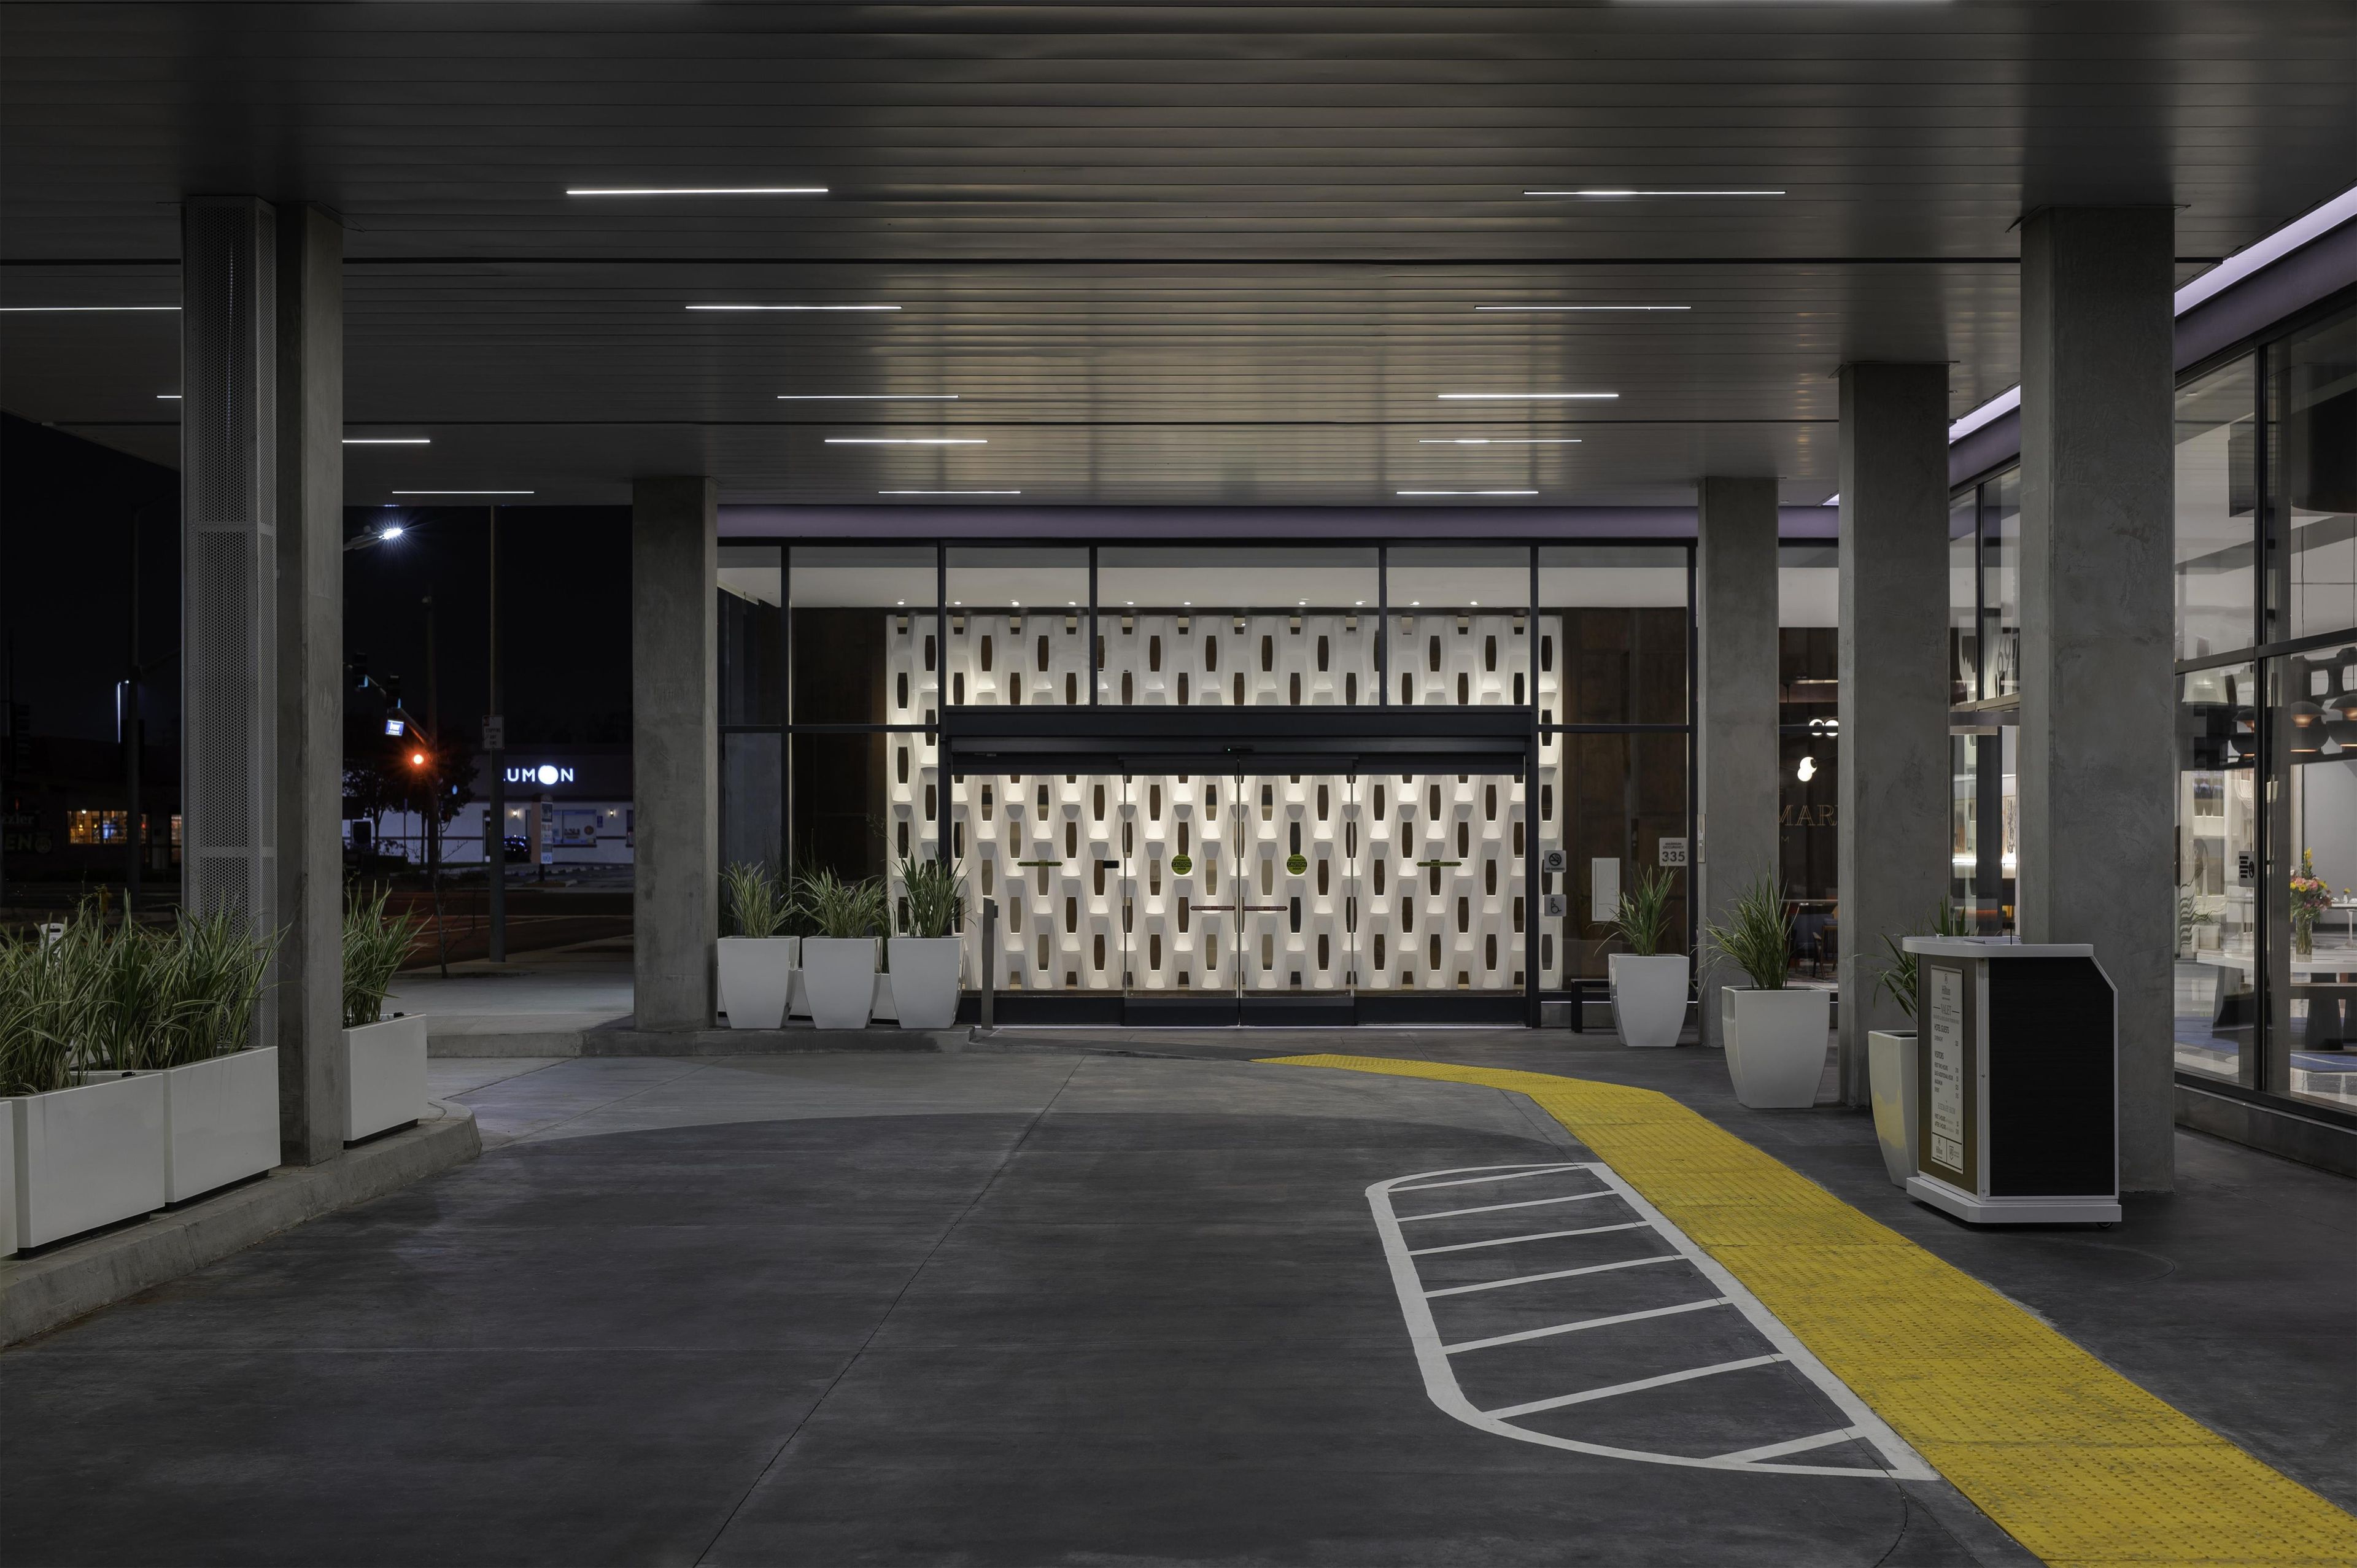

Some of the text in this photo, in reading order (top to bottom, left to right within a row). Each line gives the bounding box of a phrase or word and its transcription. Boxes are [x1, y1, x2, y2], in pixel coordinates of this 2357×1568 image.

[503, 765, 573, 785] UMON
[1778, 805, 1838, 826] MAR
[1662, 851, 1685, 862] 335
[1941, 986, 1951, 996] Hilton
[1941, 1003, 1952, 1016] VALET
[1941, 1024, 1949, 1034] GUESTS
[1934, 1051, 1945, 1060] VISITORS
